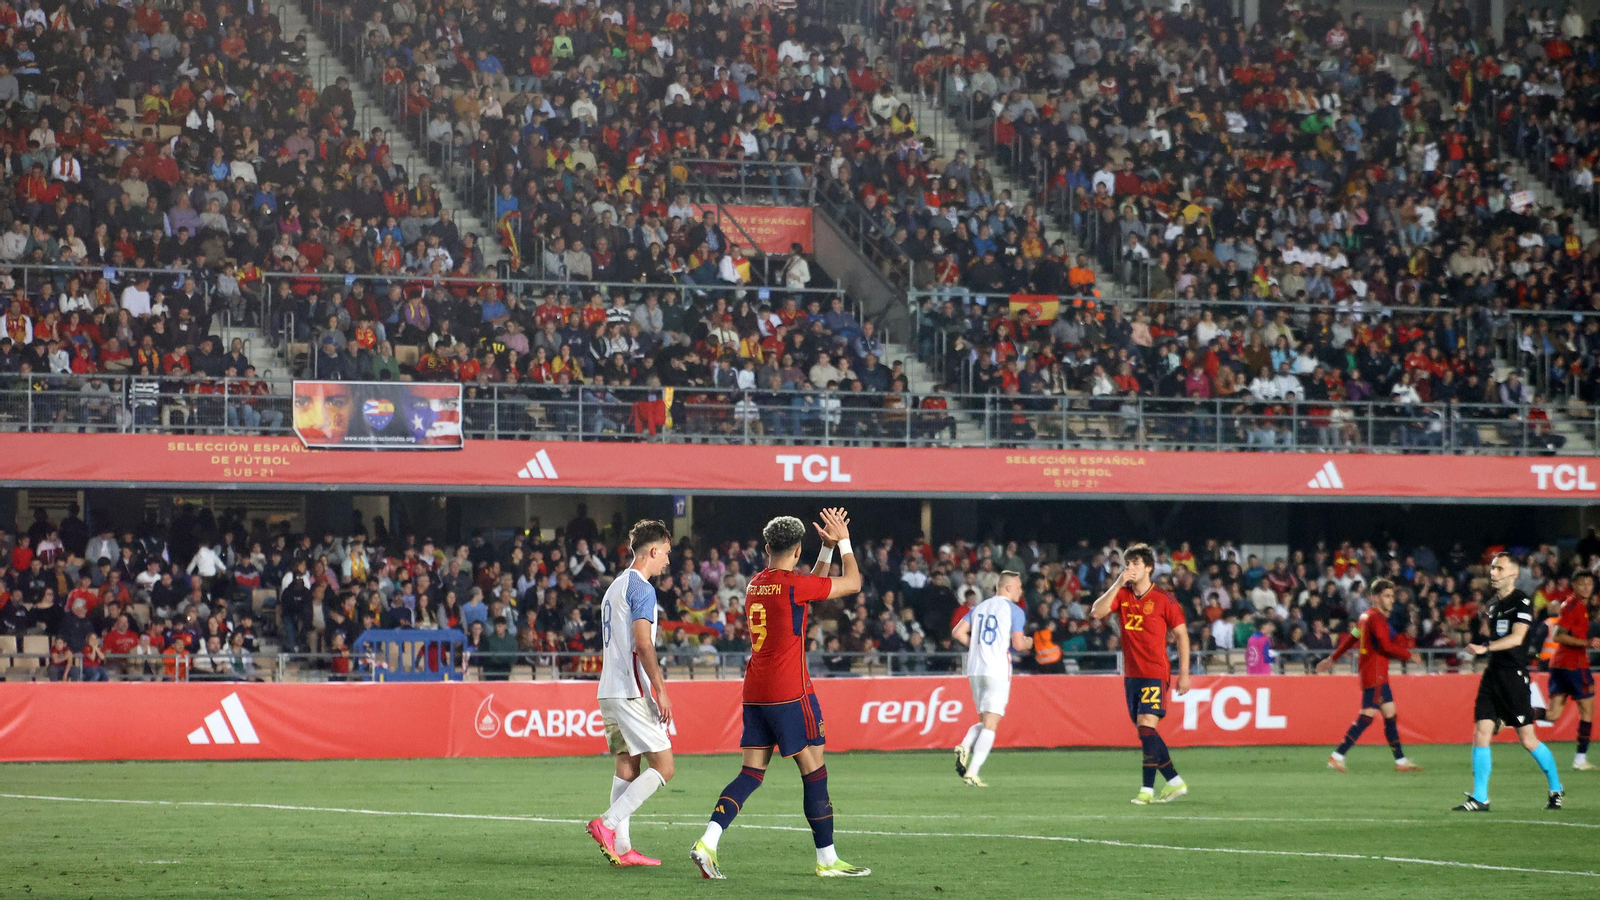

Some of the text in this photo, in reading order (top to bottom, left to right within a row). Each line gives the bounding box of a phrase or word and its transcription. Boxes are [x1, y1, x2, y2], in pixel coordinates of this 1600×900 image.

[751, 215, 806, 226] ESPAÑOLA
[167, 441, 249, 452] SELECCIÓN
[211, 454, 290, 465] DE FÚTBOL
[1005, 455, 1146, 465] SELECCIÓN ESPAÑOLA
[223, 468, 274, 477] SUB-21
[776, 454, 851, 483] TCL
[1043, 466, 1112, 477] DE FÚTBOL
[1054, 480, 1099, 488] SUB-21
[1530, 464, 1597, 491] TCL
[757, 584, 782, 595] JOSEPH
[749, 603, 768, 653] 9
[977, 613, 998, 646] 18
[1124, 613, 1143, 631] 22
[1141, 686, 1161, 703] 22
[859, 686, 964, 736] renfe
[1171, 685, 1288, 731] TCL
[504, 709, 678, 738] CABRE
